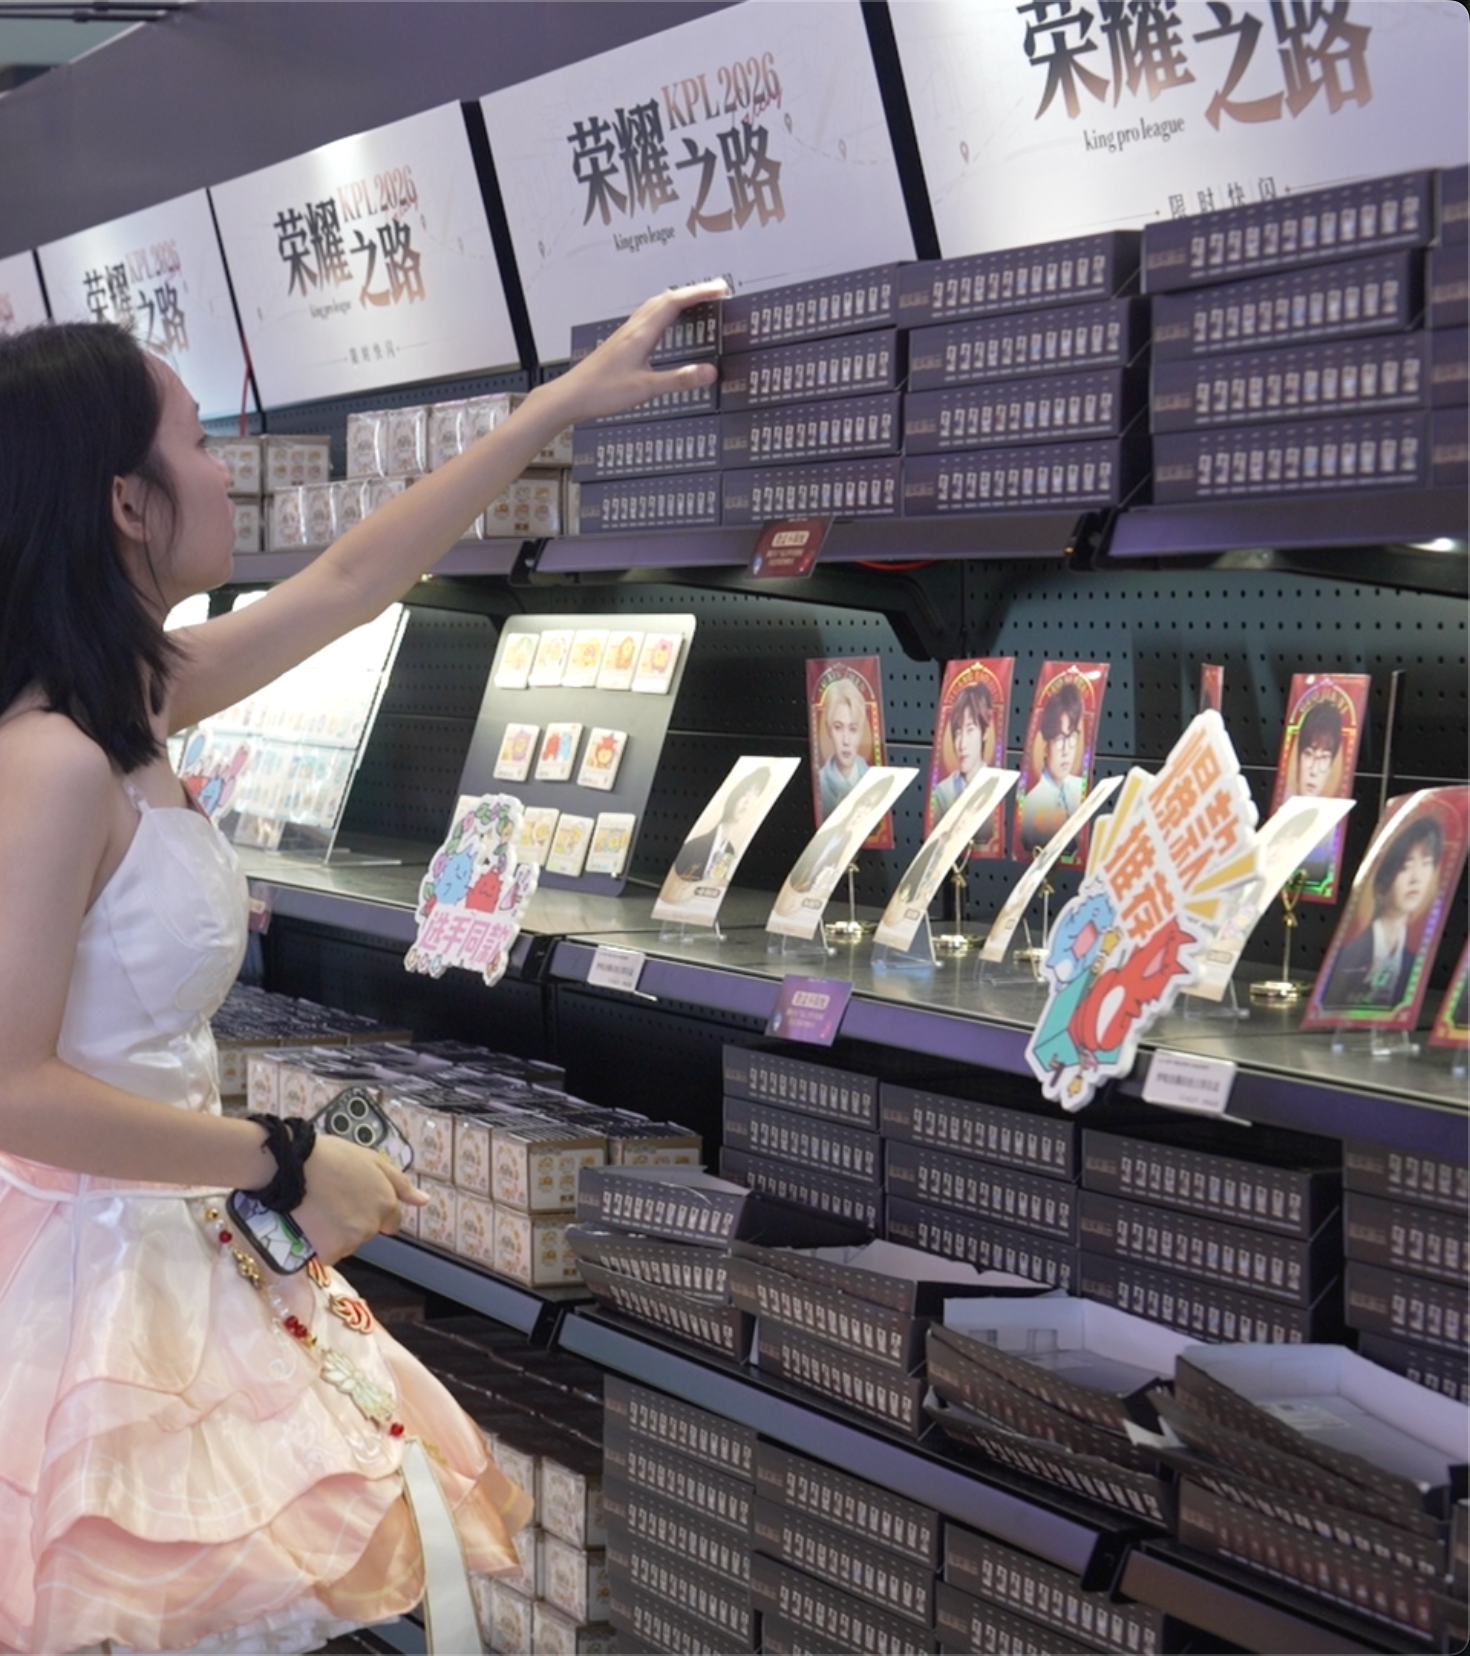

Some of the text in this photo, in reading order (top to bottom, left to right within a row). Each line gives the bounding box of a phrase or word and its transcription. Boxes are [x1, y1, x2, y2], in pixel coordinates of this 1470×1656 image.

[661, 73, 721, 131] KPL
[718, 52, 782, 113] 2026
[1017, 0, 1373, 131] 荣耀之路
[567, 98, 786, 238] 荣耀之路
[1083, 116, 1185, 153] king pro league
[273, 197, 426, 309] 荣耀之路
[1147, 727, 1239, 893] 爆款
[417, 910, 511, 966] 选手同款
[1103, 817, 1176, 942] 推荐
